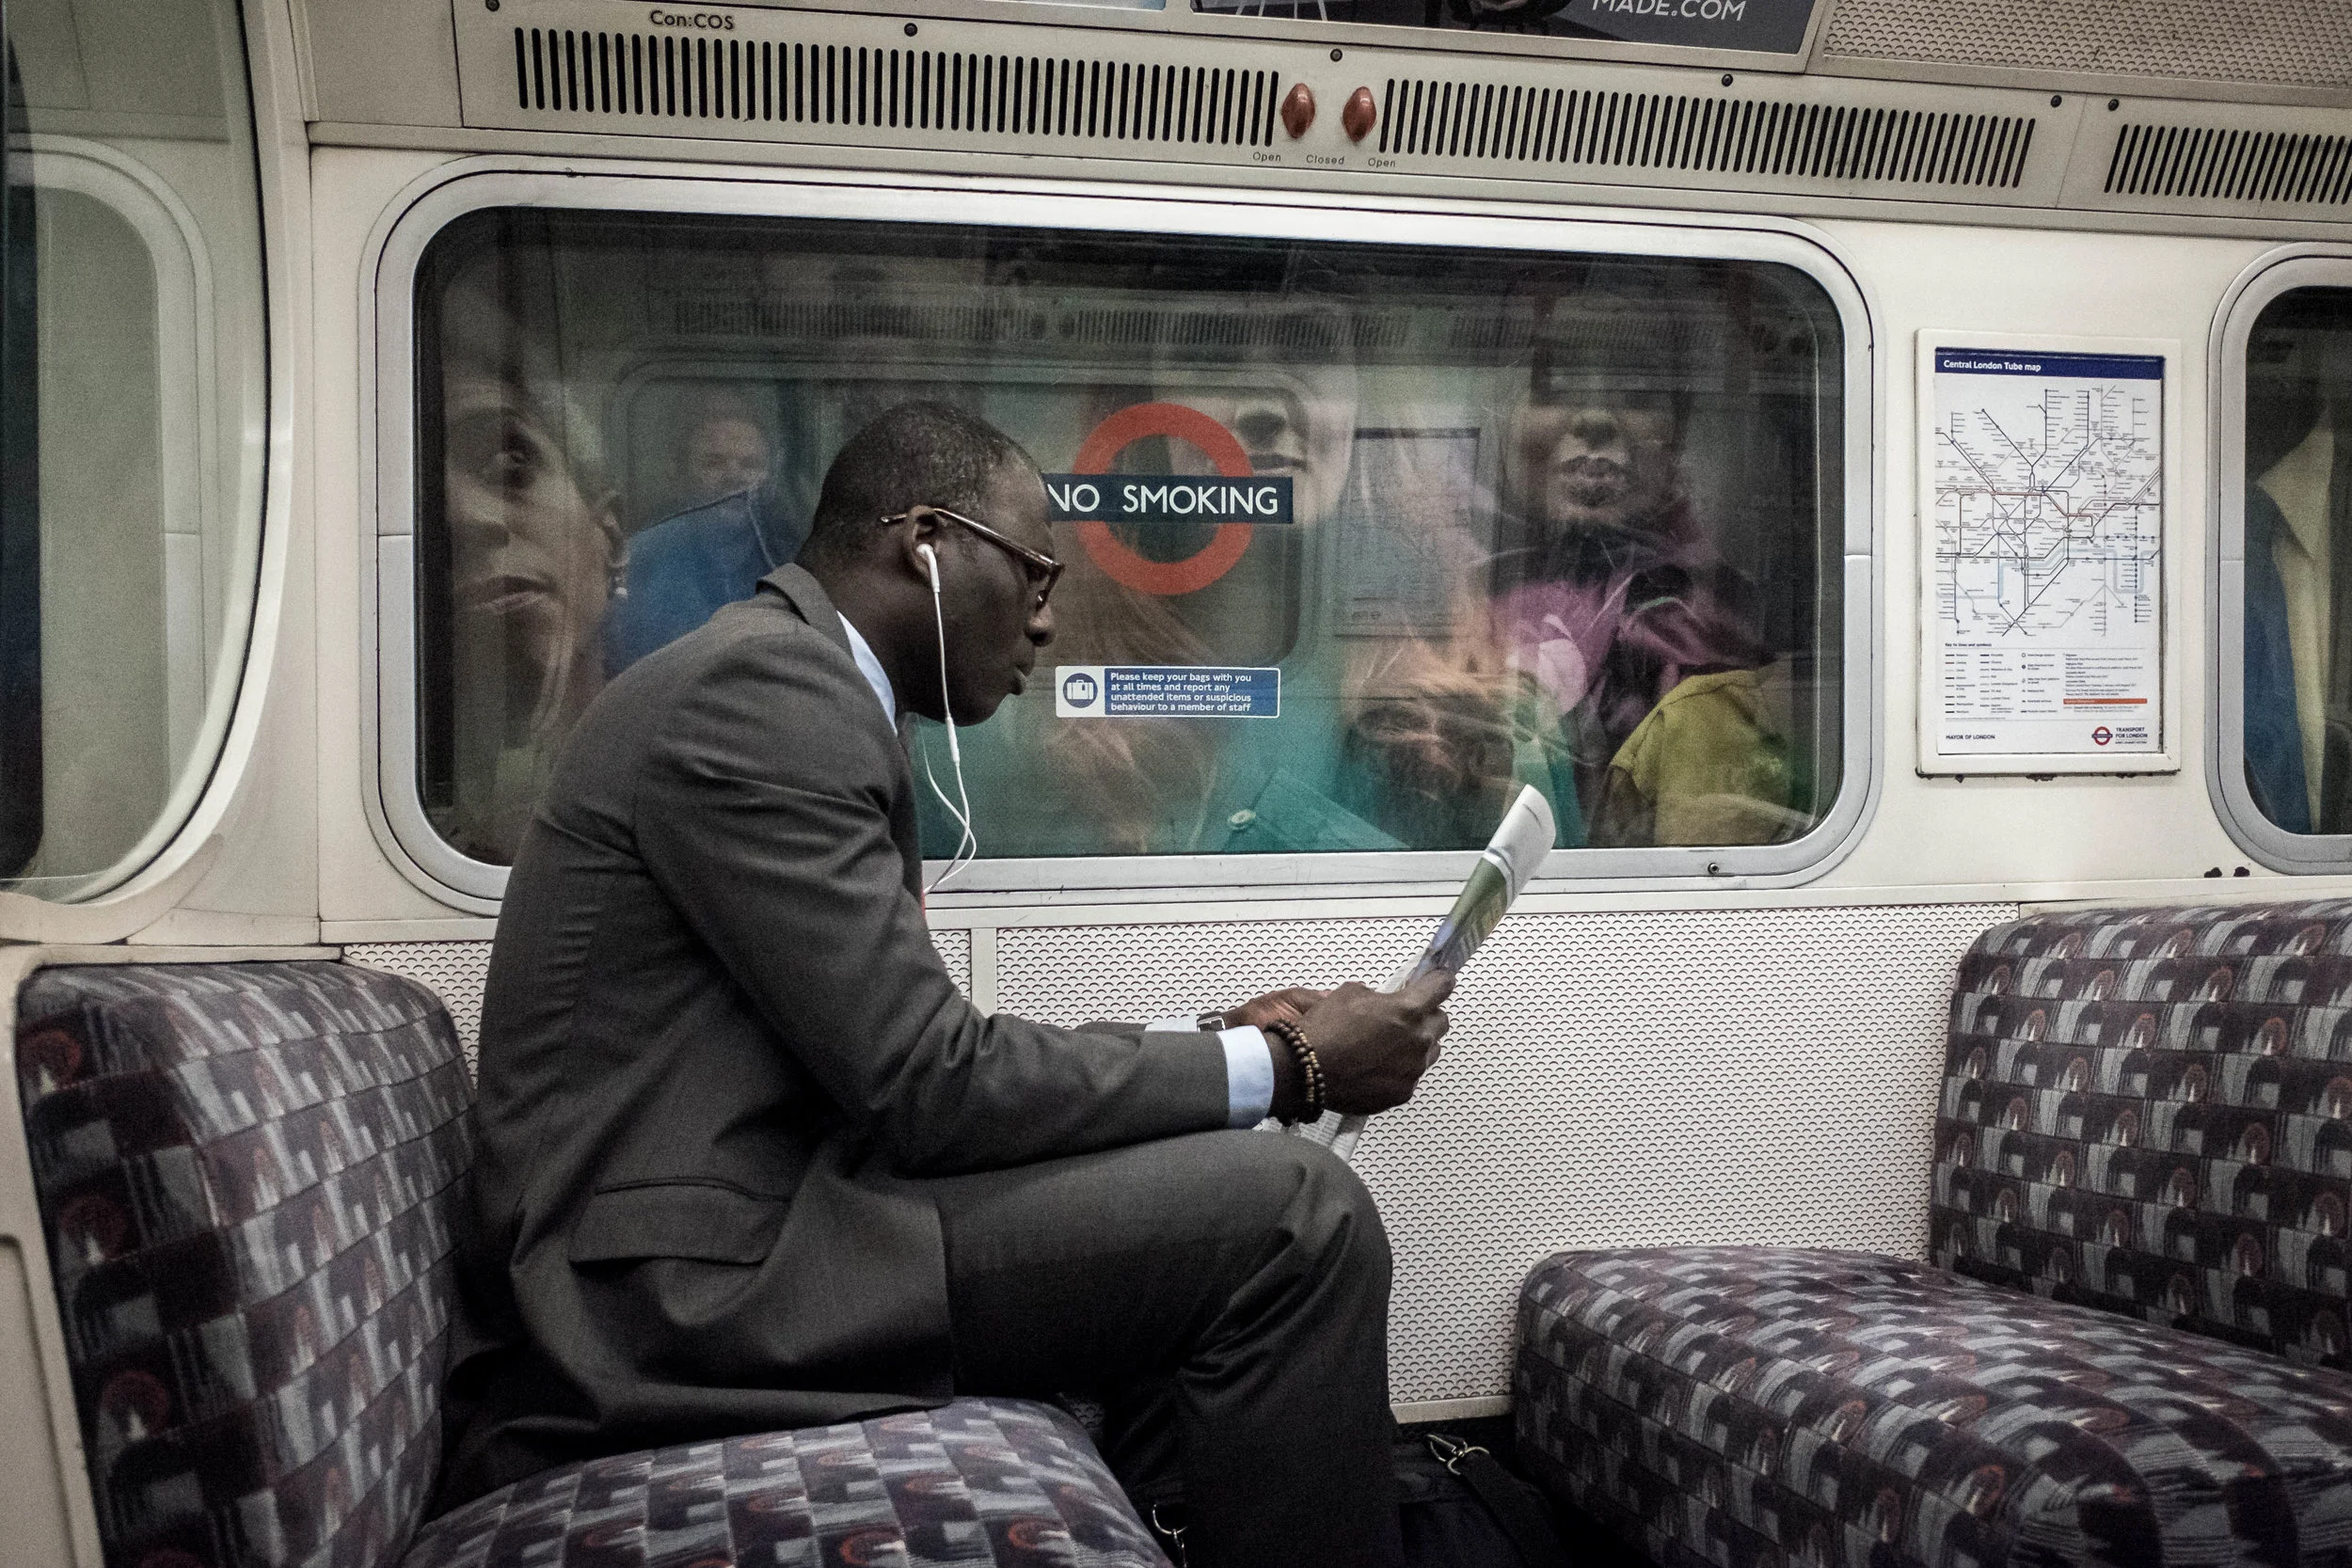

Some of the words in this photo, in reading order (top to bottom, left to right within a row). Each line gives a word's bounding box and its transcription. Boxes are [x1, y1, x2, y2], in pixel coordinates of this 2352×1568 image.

[650, 9, 734, 30] Con:COS
[1252, 151, 1281, 162] Open
[1306, 154, 1345, 165] Closed
[1368, 157, 1396, 168] Open
[1943, 359, 1972, 369] Central
[1973, 361, 2003, 370] London
[2004, 362, 2024, 371] Tube
[2025, 364, 2042, 372] map
[1047, 483, 1100, 513] NO
[1122, 484, 1278, 515] SMOKING
[1110, 673, 1140, 681] Please
[1142, 673, 1165, 683] keep
[1167, 674, 1187, 683] your
[1189, 673, 1211, 683] bags
[1212, 673, 1232, 682] with
[1234, 674, 1251, 683] you
[1122, 683, 1135, 691] all
[1136, 683, 1162, 691] times
[1164, 683, 1182, 691] and
[1183, 685, 1213, 693] report
[1110, 693, 1164, 702] unattended
[1166, 693, 1192, 702] items
[1205, 693, 1252, 704] suspicious
[1110, 703, 1156, 712] behaviour
[1158, 704, 1168, 712] to
[1177, 704, 1215, 712] member
[1217, 704, 1228, 712] of
[1229, 704, 1251, 712] staff
